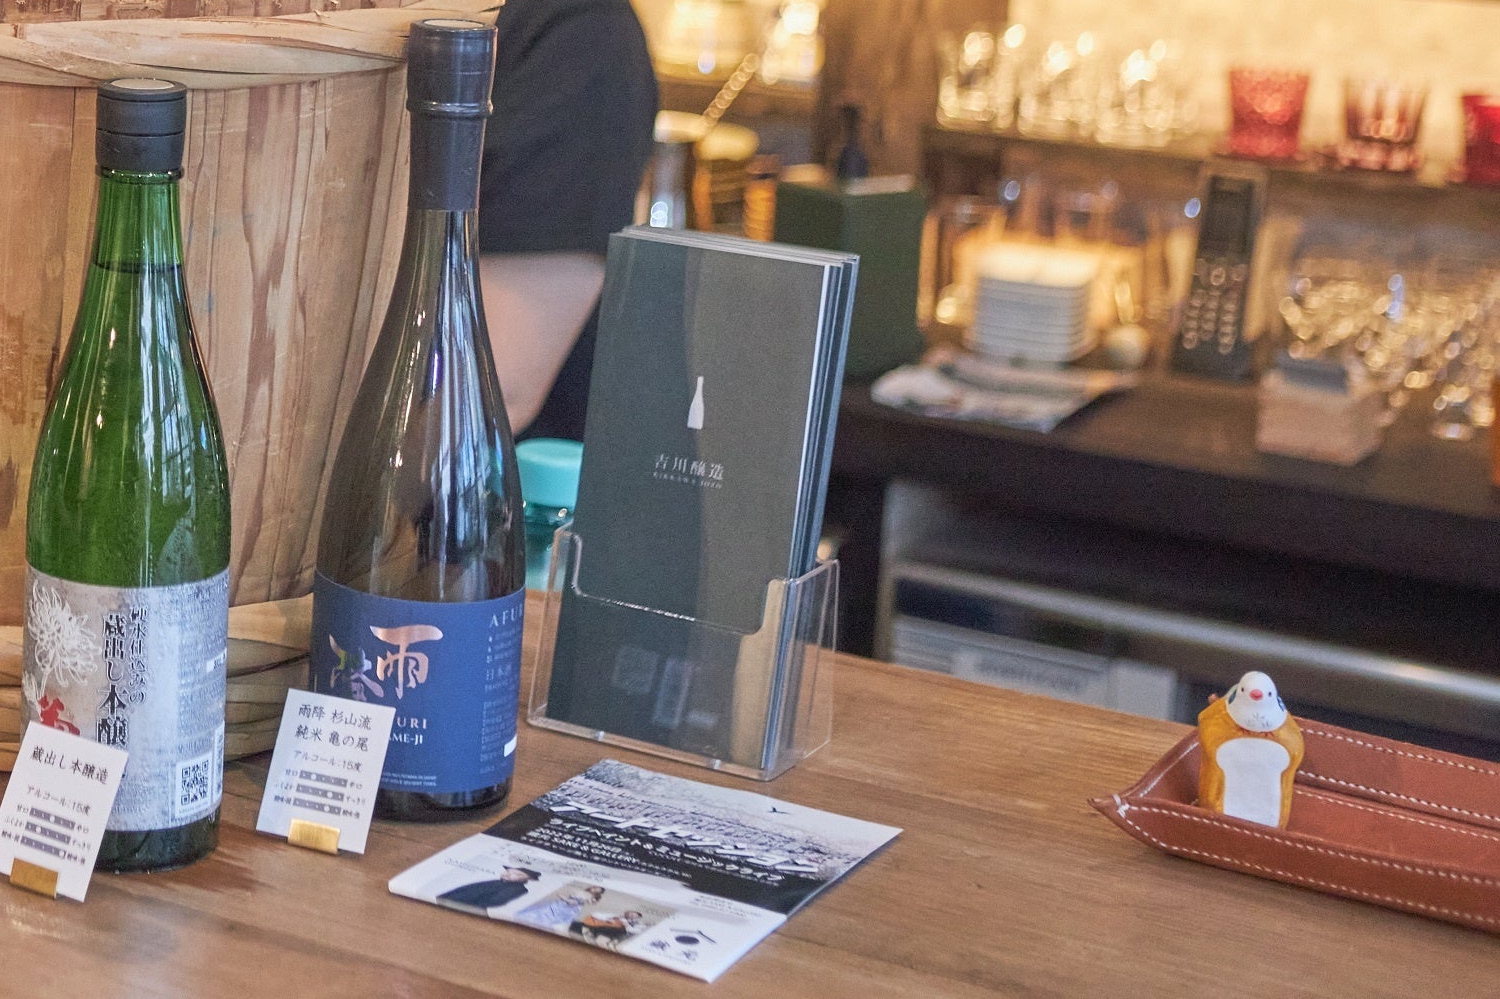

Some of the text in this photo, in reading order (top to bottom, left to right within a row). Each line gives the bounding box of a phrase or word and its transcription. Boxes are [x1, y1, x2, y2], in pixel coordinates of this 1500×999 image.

[97, 613, 128, 746] 蔵出し本醸
[298, 703, 372, 731] 雨降 杉山流
[397, 717, 428, 730] URI
[295, 724, 369, 752] 純米 亀の尾
[390, 732, 424, 745] ME-JI
[31, 745, 109, 785] 蔵出し本醸造
